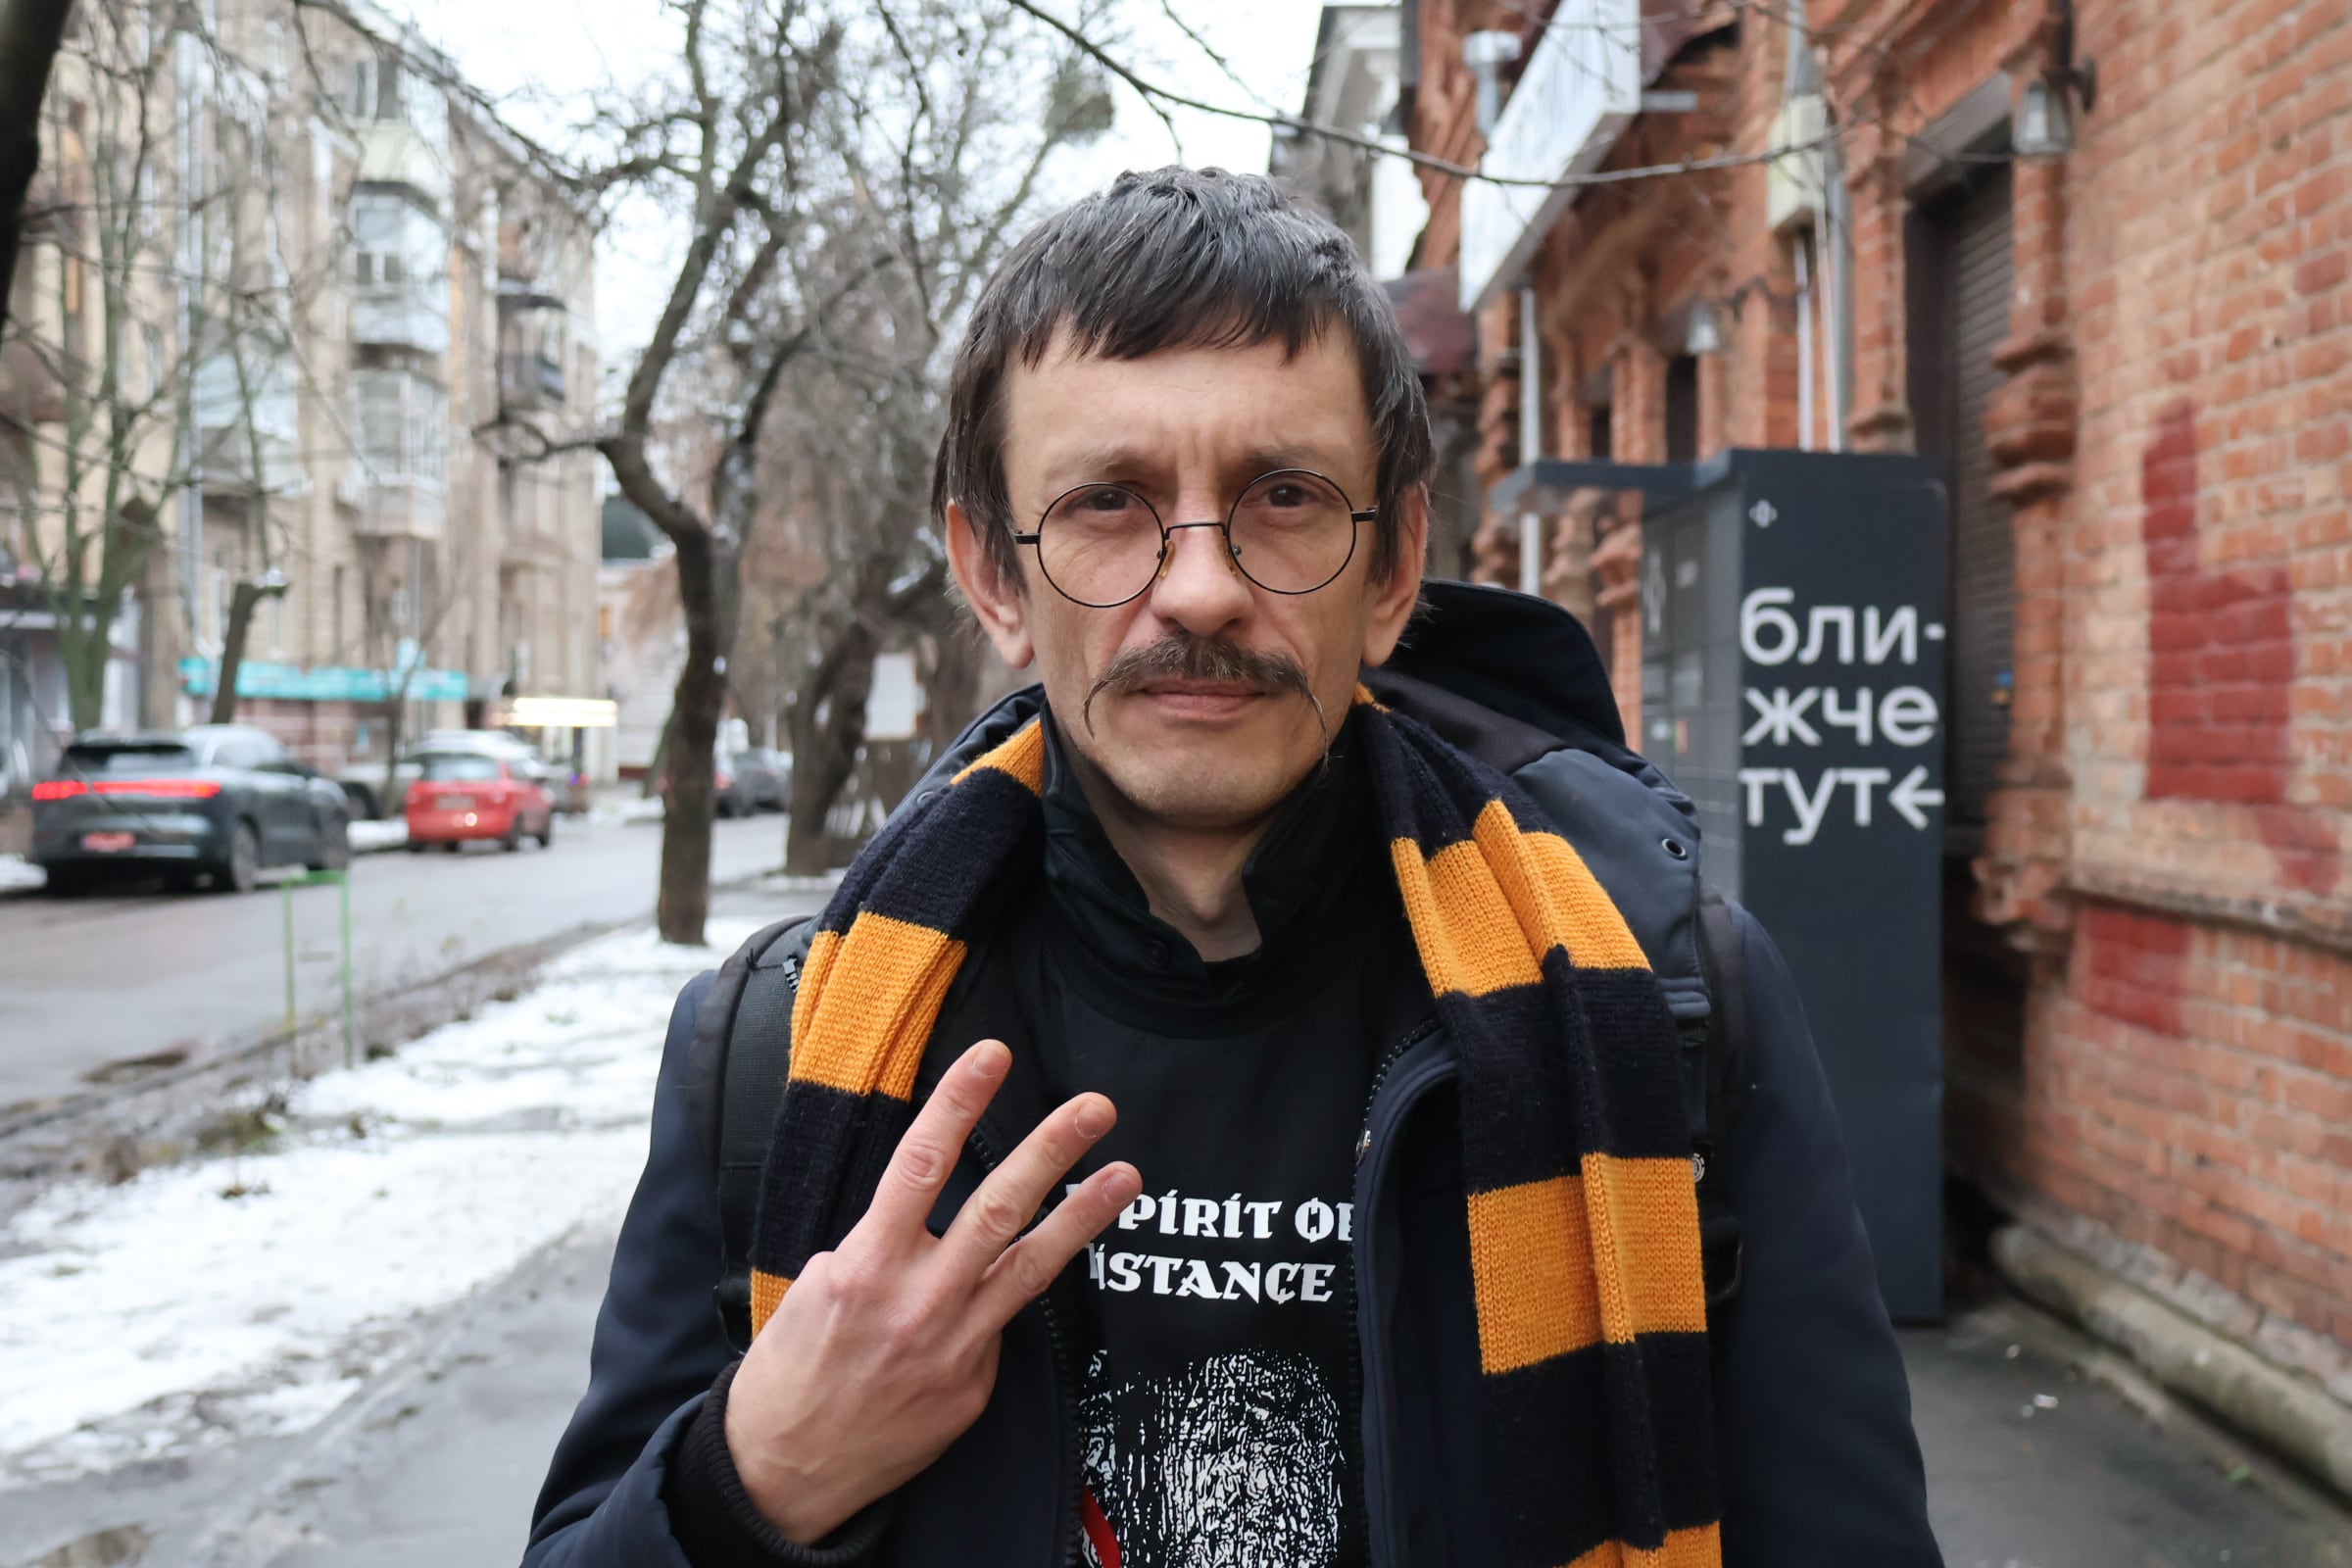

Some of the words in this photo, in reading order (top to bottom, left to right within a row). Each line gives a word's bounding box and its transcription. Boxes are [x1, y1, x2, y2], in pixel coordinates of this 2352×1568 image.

[1740, 587, 1946, 665] бли-
[1741, 686, 1938, 747] жче
[1738, 767, 1890, 845] тут
